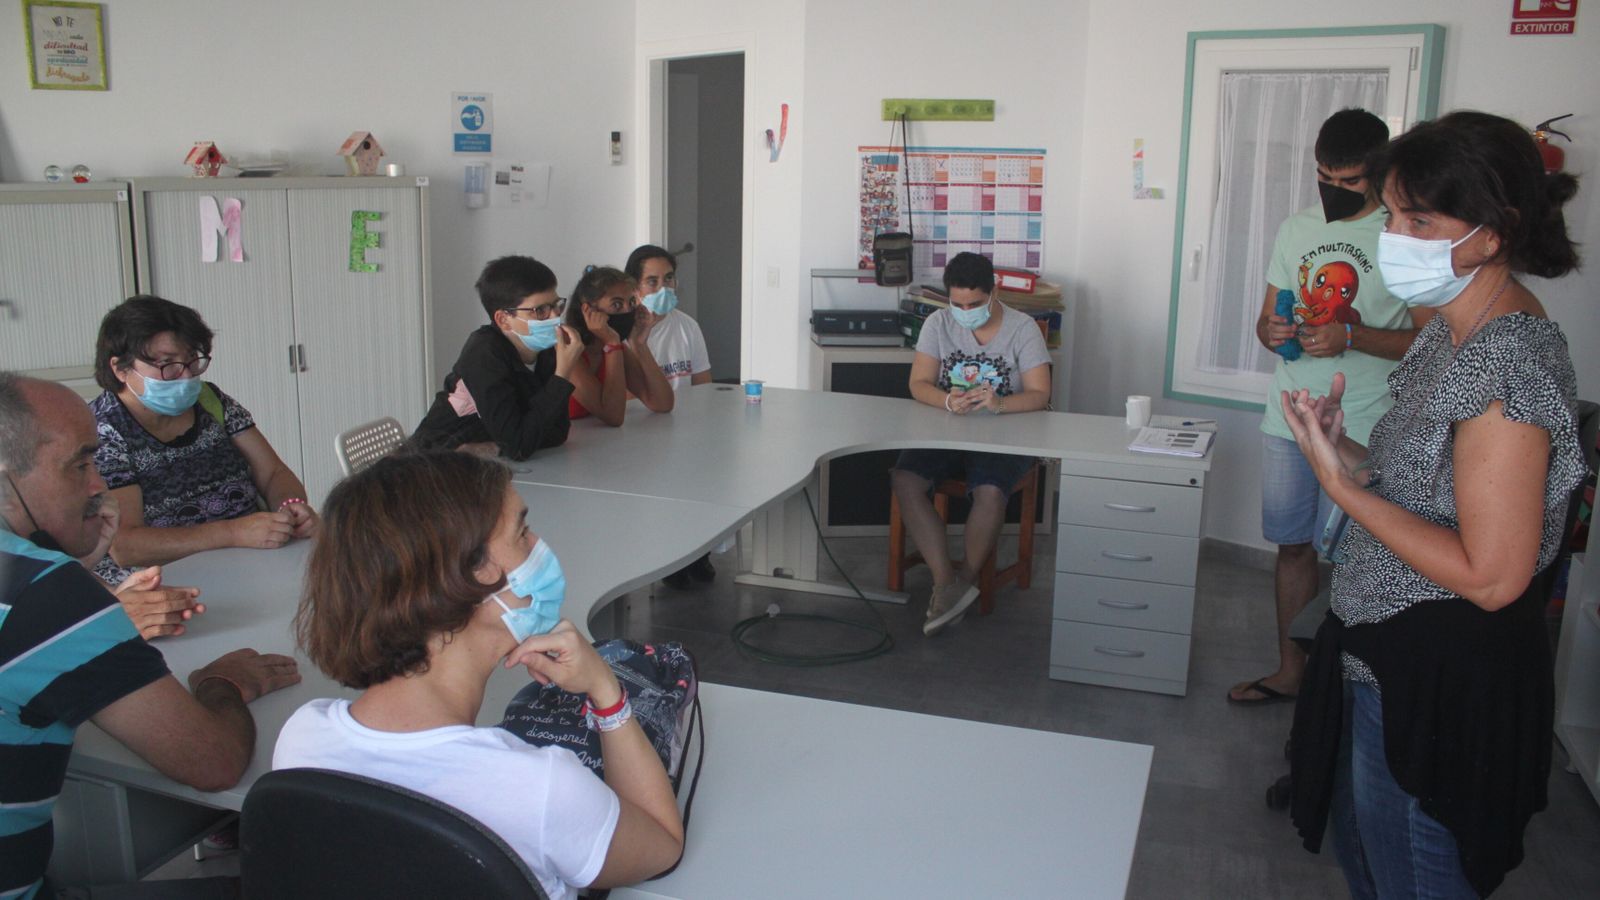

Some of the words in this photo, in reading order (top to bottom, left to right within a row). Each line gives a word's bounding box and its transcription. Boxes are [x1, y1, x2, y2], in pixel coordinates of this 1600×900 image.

[1515, 23, 1569, 33] EXTINTOR
[200, 195, 244, 263] M
[349, 210, 381, 273] E
[1301, 250, 1317, 263] I'M
[1317, 242, 1373, 274] MULTITASKING
[519, 713, 554, 724] made
[559, 716, 571, 726] to
[525, 724, 589, 746] discovered.
